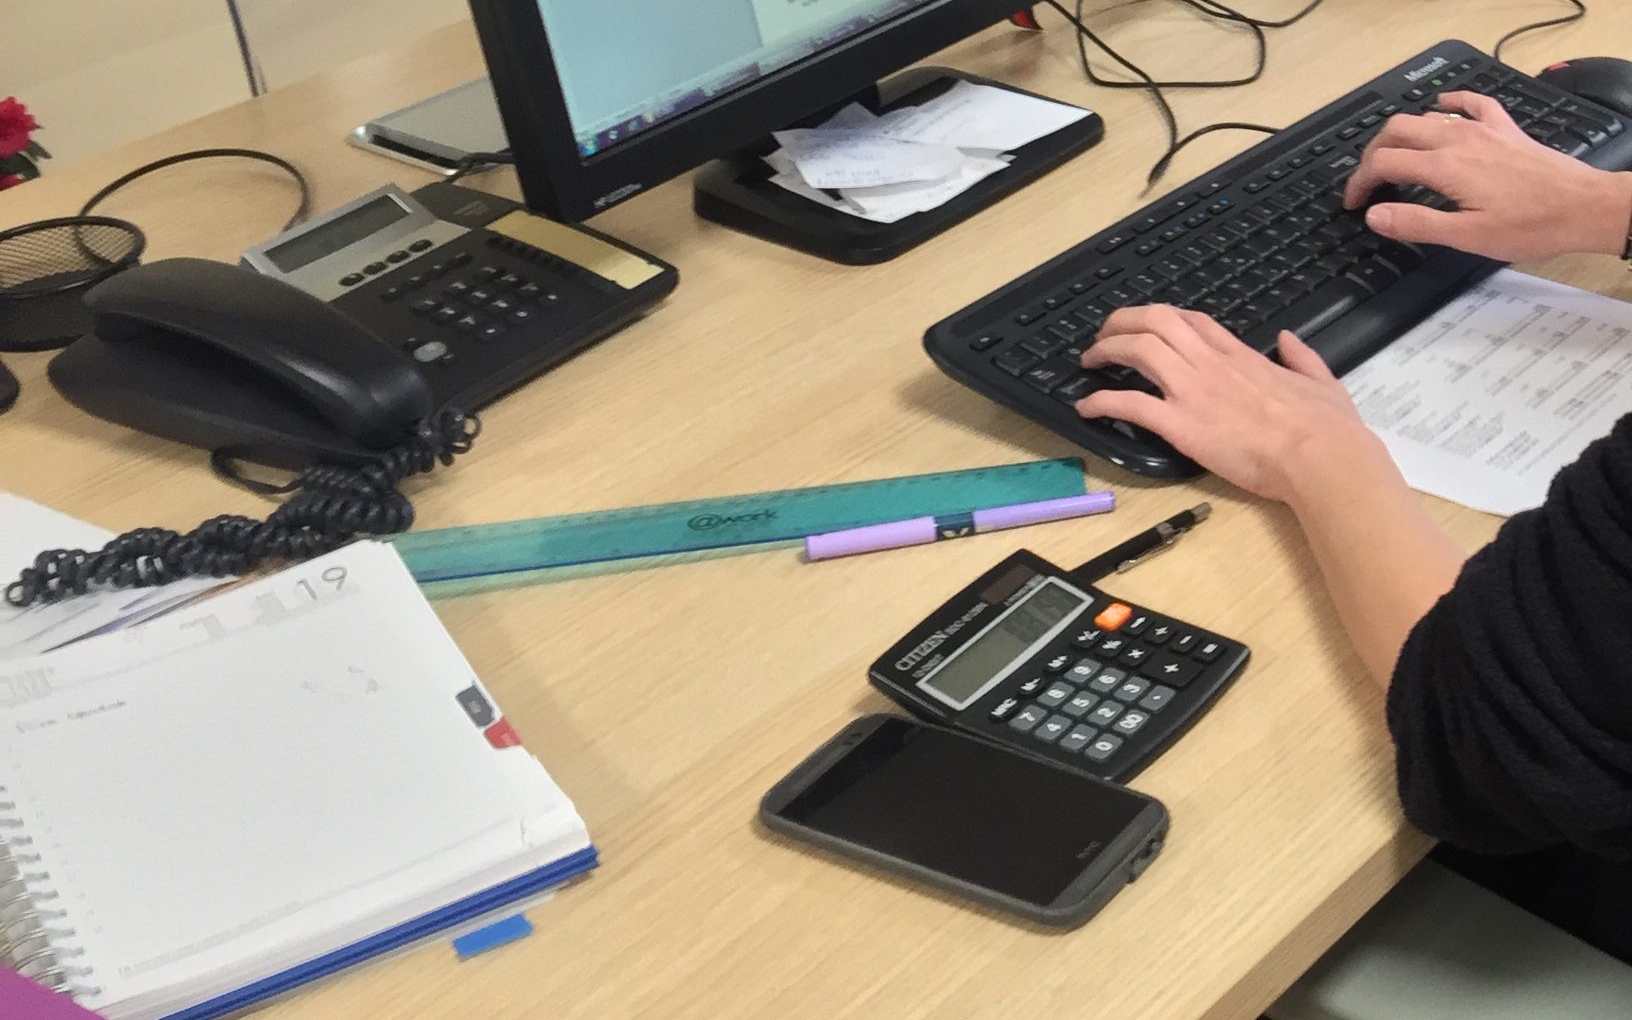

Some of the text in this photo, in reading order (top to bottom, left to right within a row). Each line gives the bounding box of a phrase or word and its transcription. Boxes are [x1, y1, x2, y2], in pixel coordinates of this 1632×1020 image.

[1403, 56, 1450, 83] Microsoft
[687, 510, 779, 531] @work
[297, 566, 348, 600] 19
[895, 630, 949, 671] CITIZEN
